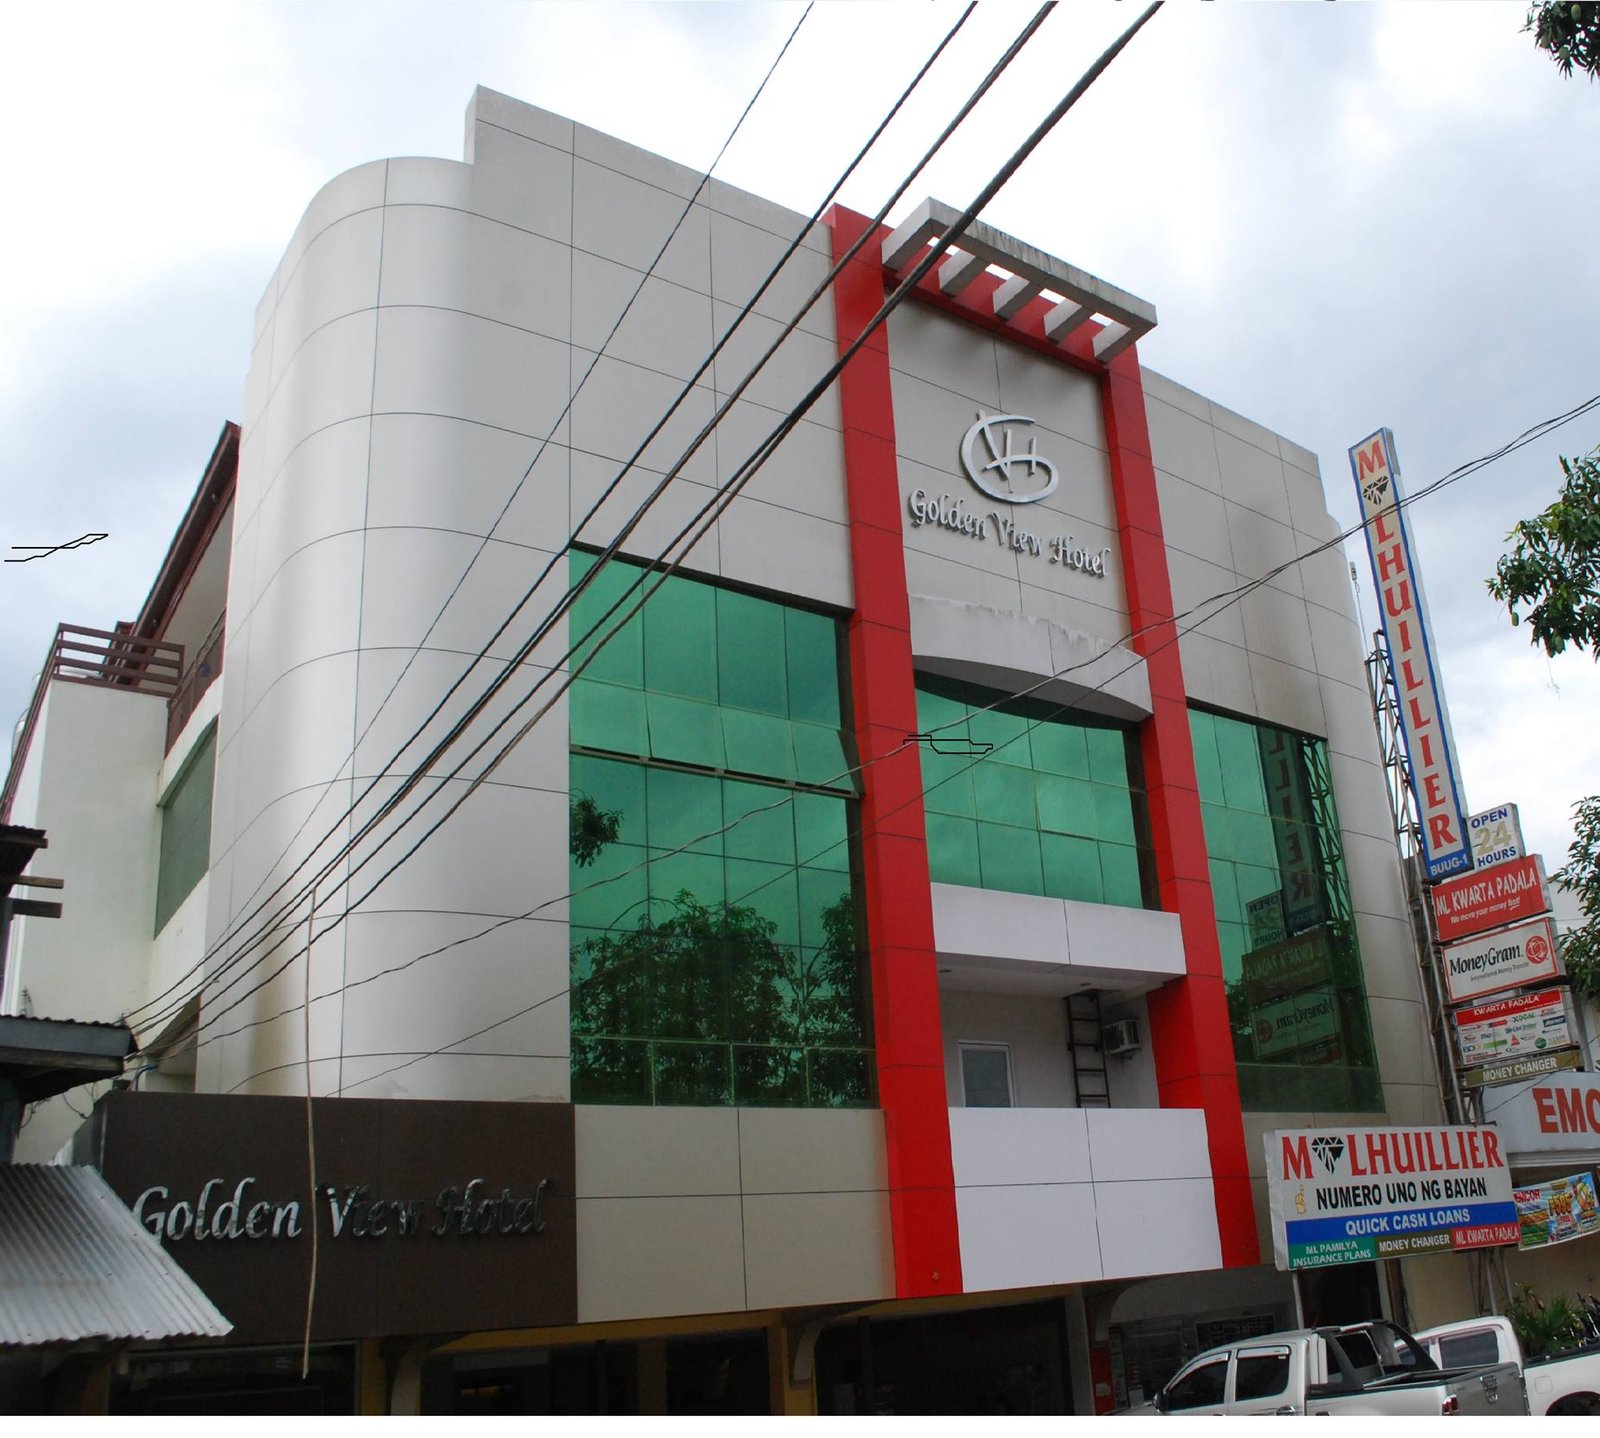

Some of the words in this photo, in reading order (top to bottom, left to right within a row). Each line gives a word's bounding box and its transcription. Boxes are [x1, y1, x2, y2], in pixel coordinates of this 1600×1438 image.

[909, 488, 987, 540] Golden
[987, 511, 1043, 556] View
[1049, 535, 1111, 578] Hotel
[1471, 808, 1508, 829] OPEN
[1474, 821, 1512, 855] 24
[1430, 854, 1469, 876] BUUG-1
[1478, 846, 1517, 868] HOURS
[1451, 881, 1495, 912] KWARTA
[1496, 867, 1537, 897] PADALA
[1473, 1003, 1507, 1017] KWARTA
[1508, 994, 1539, 1008] PADALA
[1483, 1066, 1513, 1082] MONEY
[1514, 1057, 1558, 1076] CHANGER
[1316, 1183, 1381, 1210] NUMERO
[1386, 1180, 1417, 1205] UNO
[1421, 1179, 1442, 1201] NG
[1444, 1176, 1487, 1199] BAYAN
[132, 1177, 302, 1241] Golden
[315, 1181, 422, 1238] View
[432, 1178, 552, 1236] Hotel
[1345, 1215, 1389, 1237] QUICK
[1393, 1212, 1428, 1230] CASH
[1431, 1208, 1471, 1226] LOANS
[1378, 1239, 1409, 1252] MONEY
[1411, 1234, 1450, 1249] CHANGER
[1467, 1228, 1494, 1243] KWARTA
[1494, 1226, 1519, 1241] PADALA
[1293, 1252, 1343, 1268] INSURANCE
[1344, 1248, 1371, 1261] PLANS
[1319, 1240, 1358, 1253] PAMILYA
